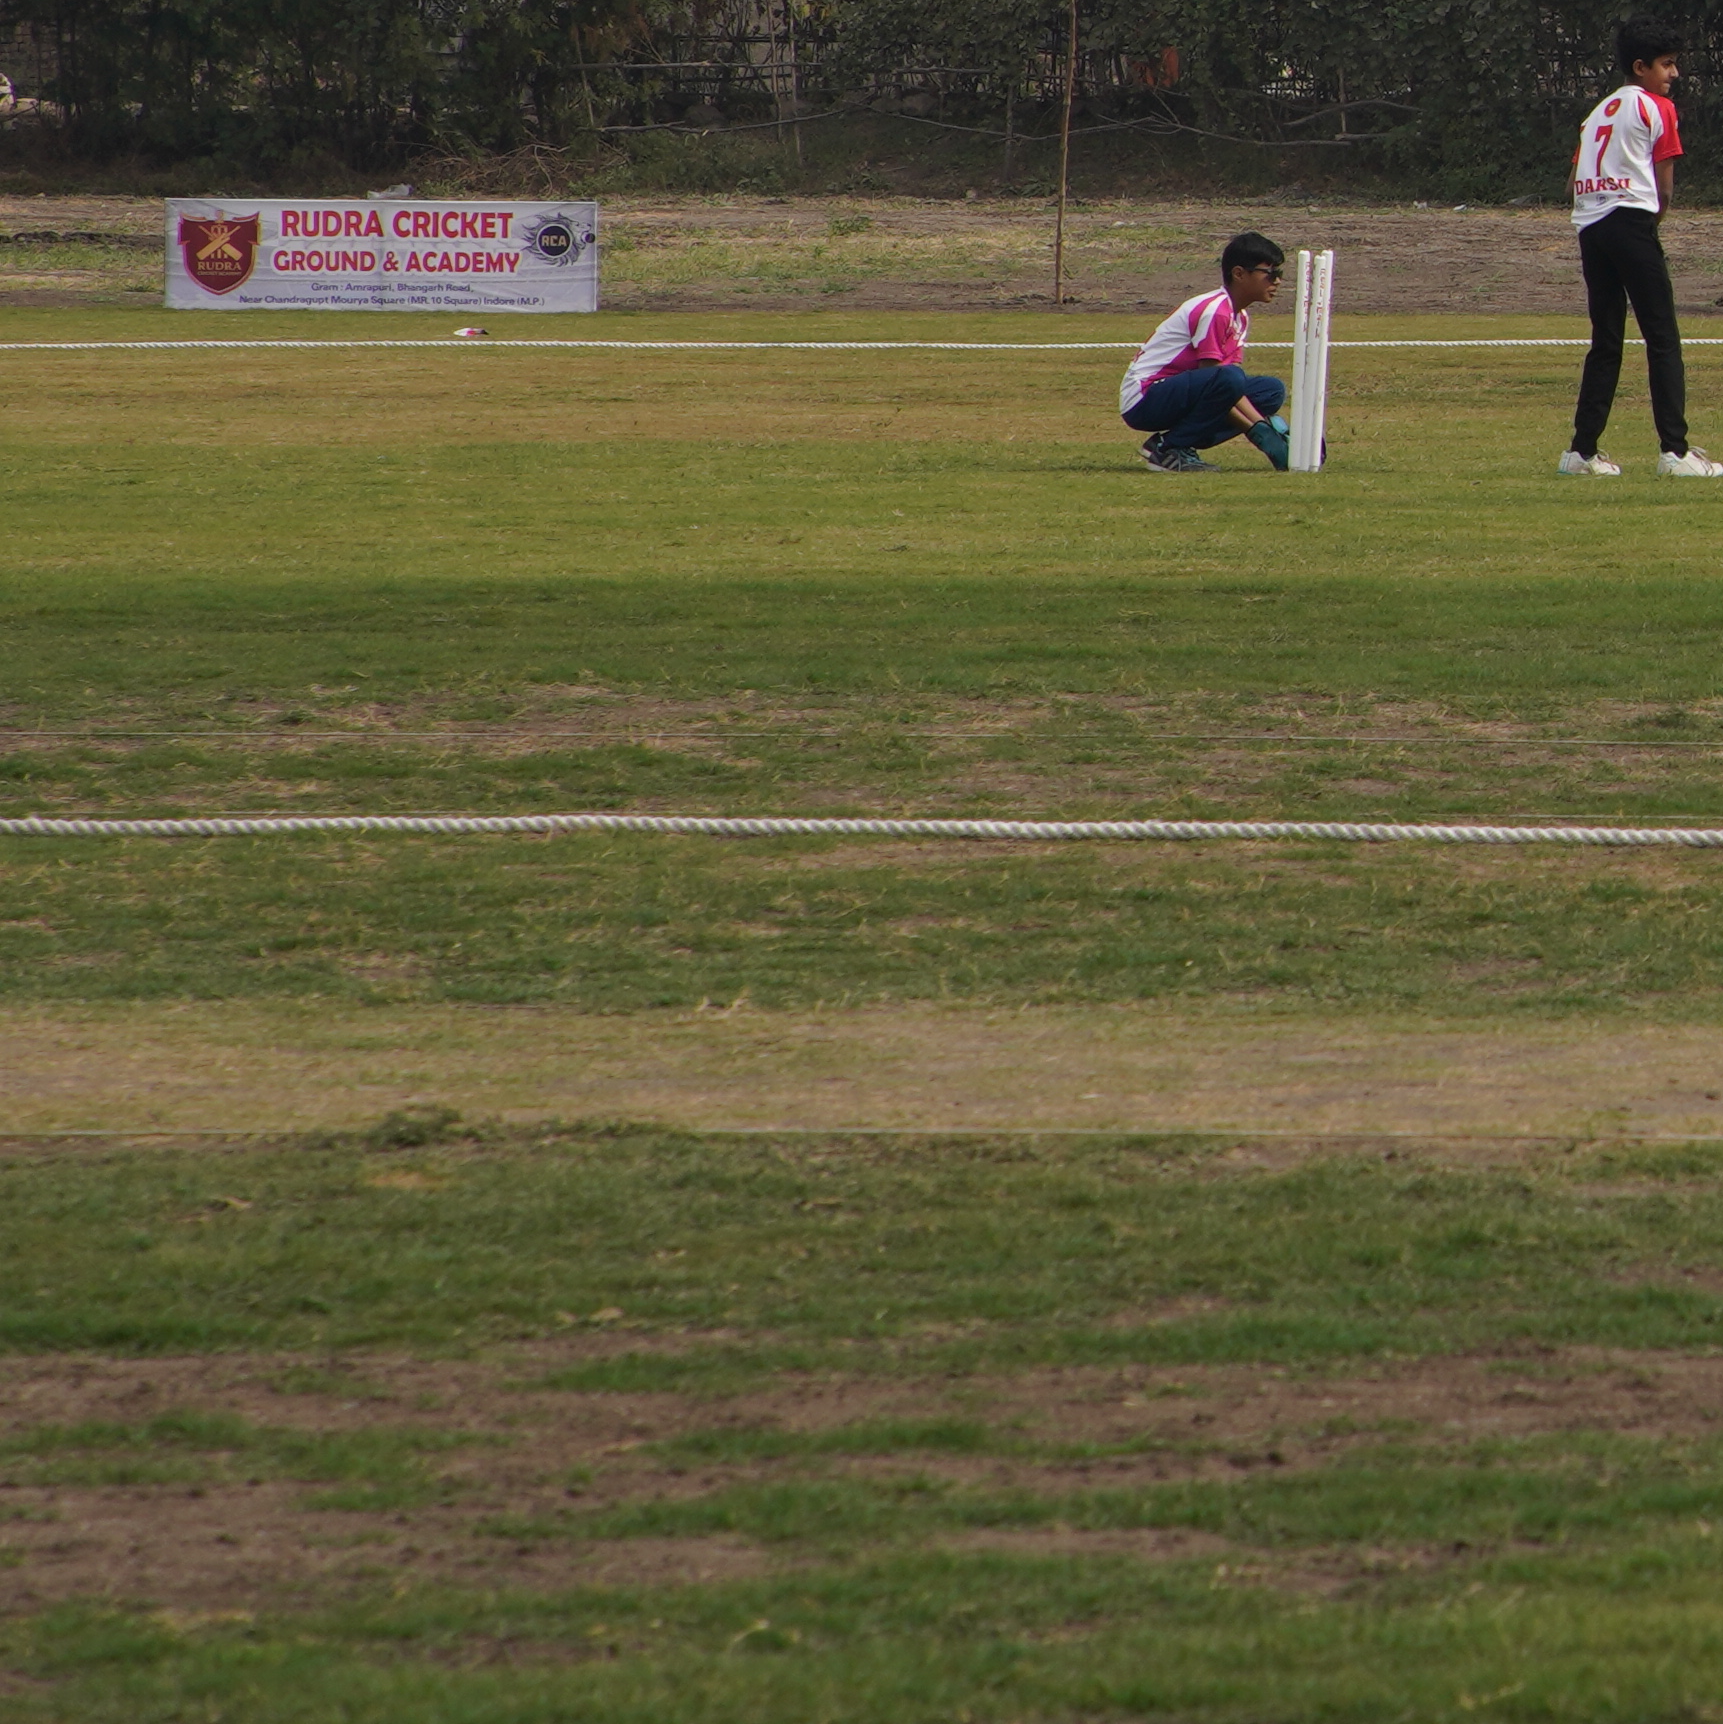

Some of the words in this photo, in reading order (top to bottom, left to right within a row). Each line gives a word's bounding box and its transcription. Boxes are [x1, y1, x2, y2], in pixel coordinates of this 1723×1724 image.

[1595, 124, 1614, 177] 7
[281, 210, 384, 238] RUDRA
[392, 210, 513, 239] CRICKET
[541, 235, 567, 247] RCA
[197, 261, 241, 271] RUDRA
[273, 250, 376, 272] GROUND
[382, 251, 399, 272] &
[405, 251, 520, 273] ACADEMY
[311, 283, 338, 291] Gram
[397, 283, 444, 293] Bhangarh
[239, 295, 263, 304] Near
[264, 295, 329, 305] Chandragupt
[330, 295, 368, 305] Mourya
[370, 296, 405, 305] Square
[443, 295, 482, 306] Square)
[484, 296, 515, 305] Indore
